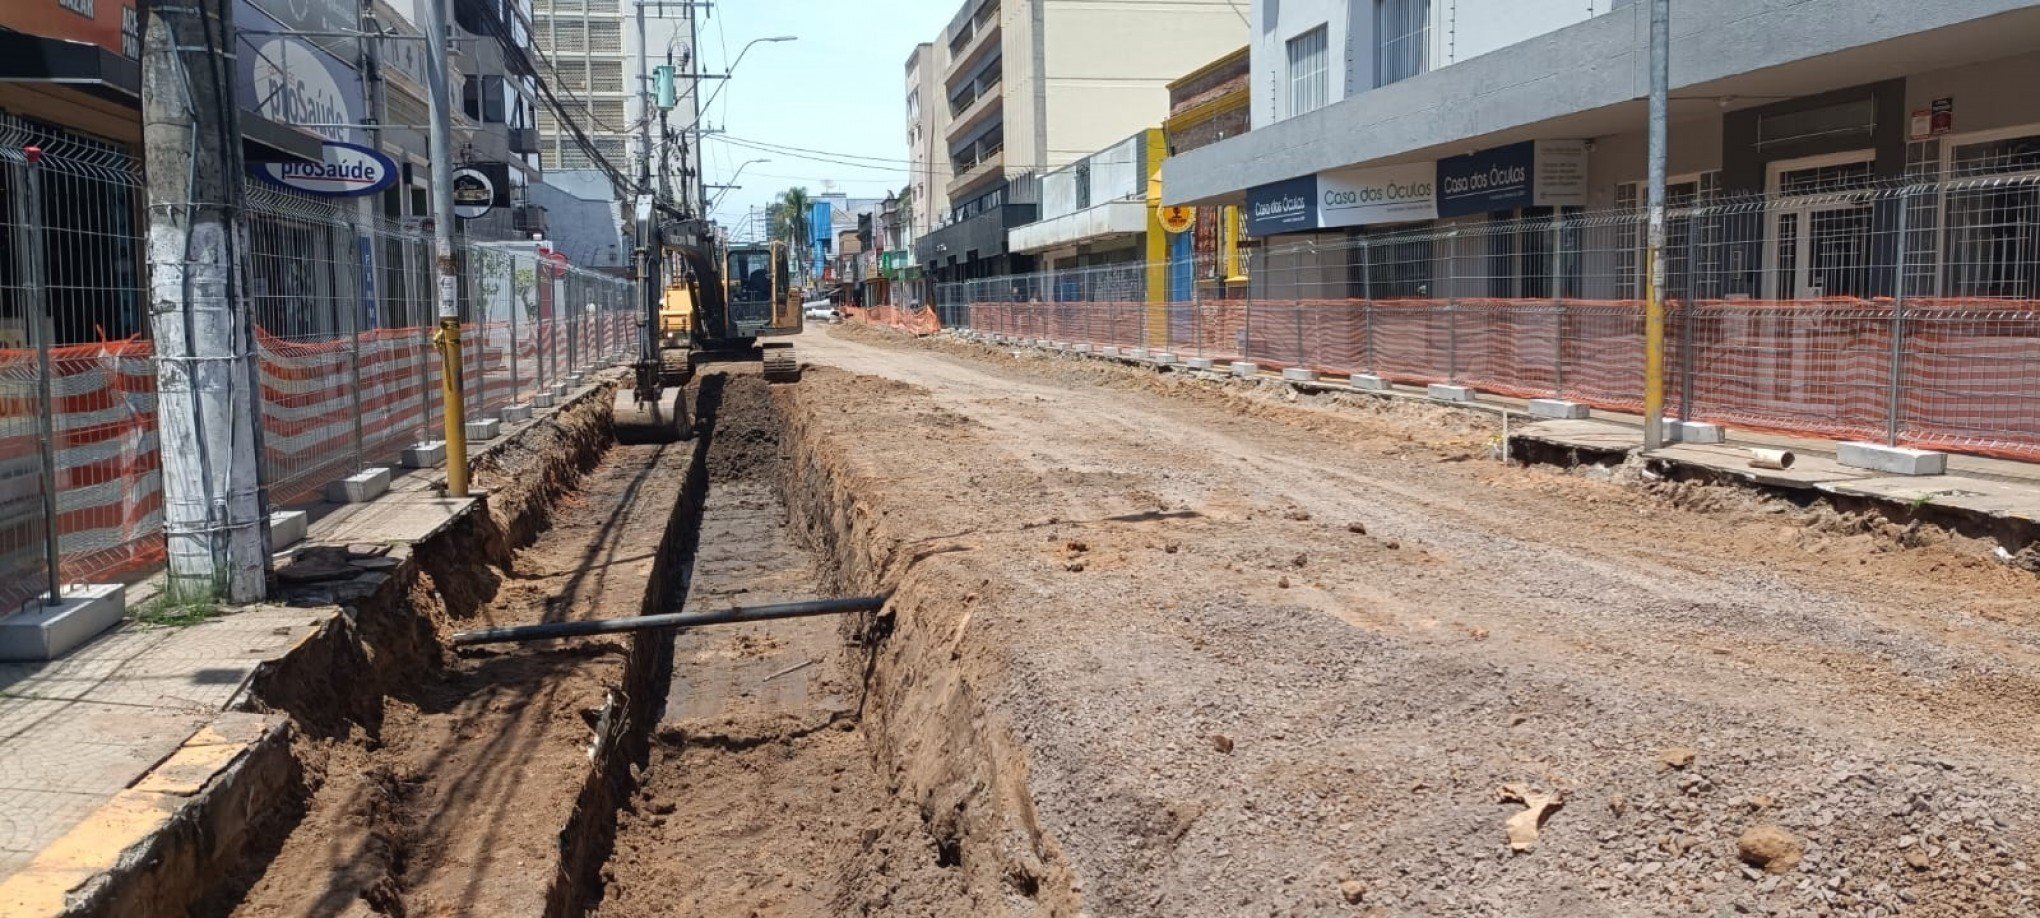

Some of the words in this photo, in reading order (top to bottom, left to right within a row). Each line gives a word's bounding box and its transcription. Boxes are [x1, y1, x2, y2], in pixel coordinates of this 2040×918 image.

[281, 159, 376, 180] proSaúde
[1445, 176, 1468, 194] Casa
[1469, 171, 1488, 190] dos
[1489, 163, 1526, 186] Óculos
[1324, 189, 1356, 206] Casa
[1360, 186, 1383, 202] dos
[1386, 179, 1432, 200] Óculos
[1255, 201, 1271, 217] Casa
